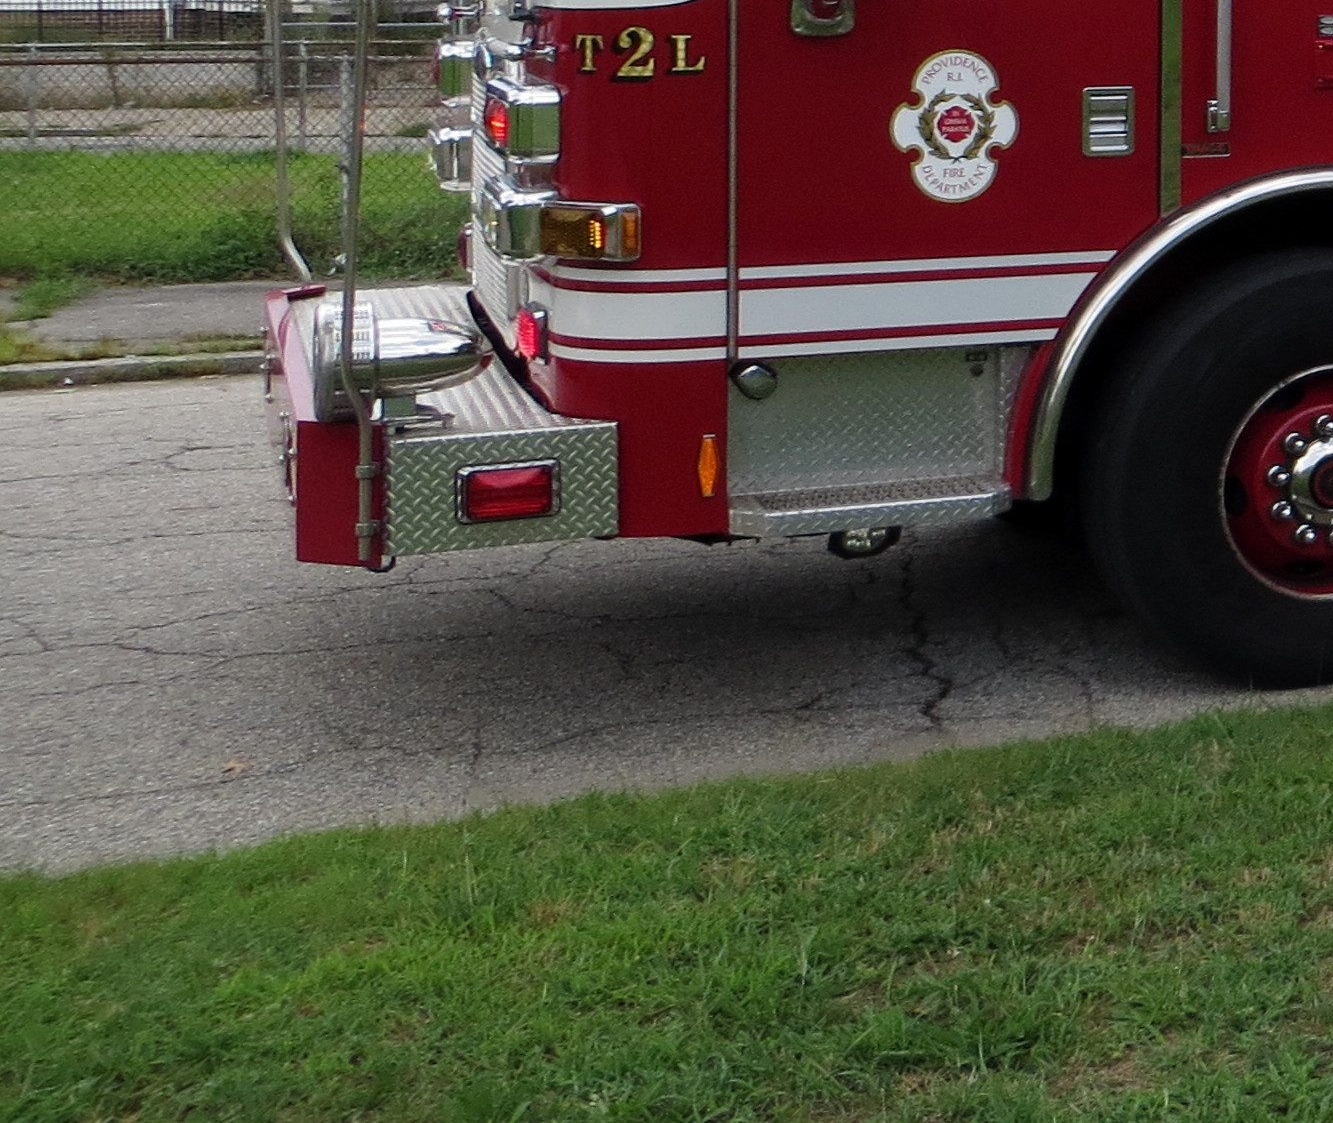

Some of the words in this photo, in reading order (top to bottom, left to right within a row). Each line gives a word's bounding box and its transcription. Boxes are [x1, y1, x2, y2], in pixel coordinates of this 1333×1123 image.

[575, 34, 604, 72] T
[616, 25, 656, 80] 2
[669, 34, 706, 73] L
[921, 56, 989, 85] PROVIDENCE
[922, 164, 988, 194] DEPARTMENT
[943, 167, 966, 178] FIRE
